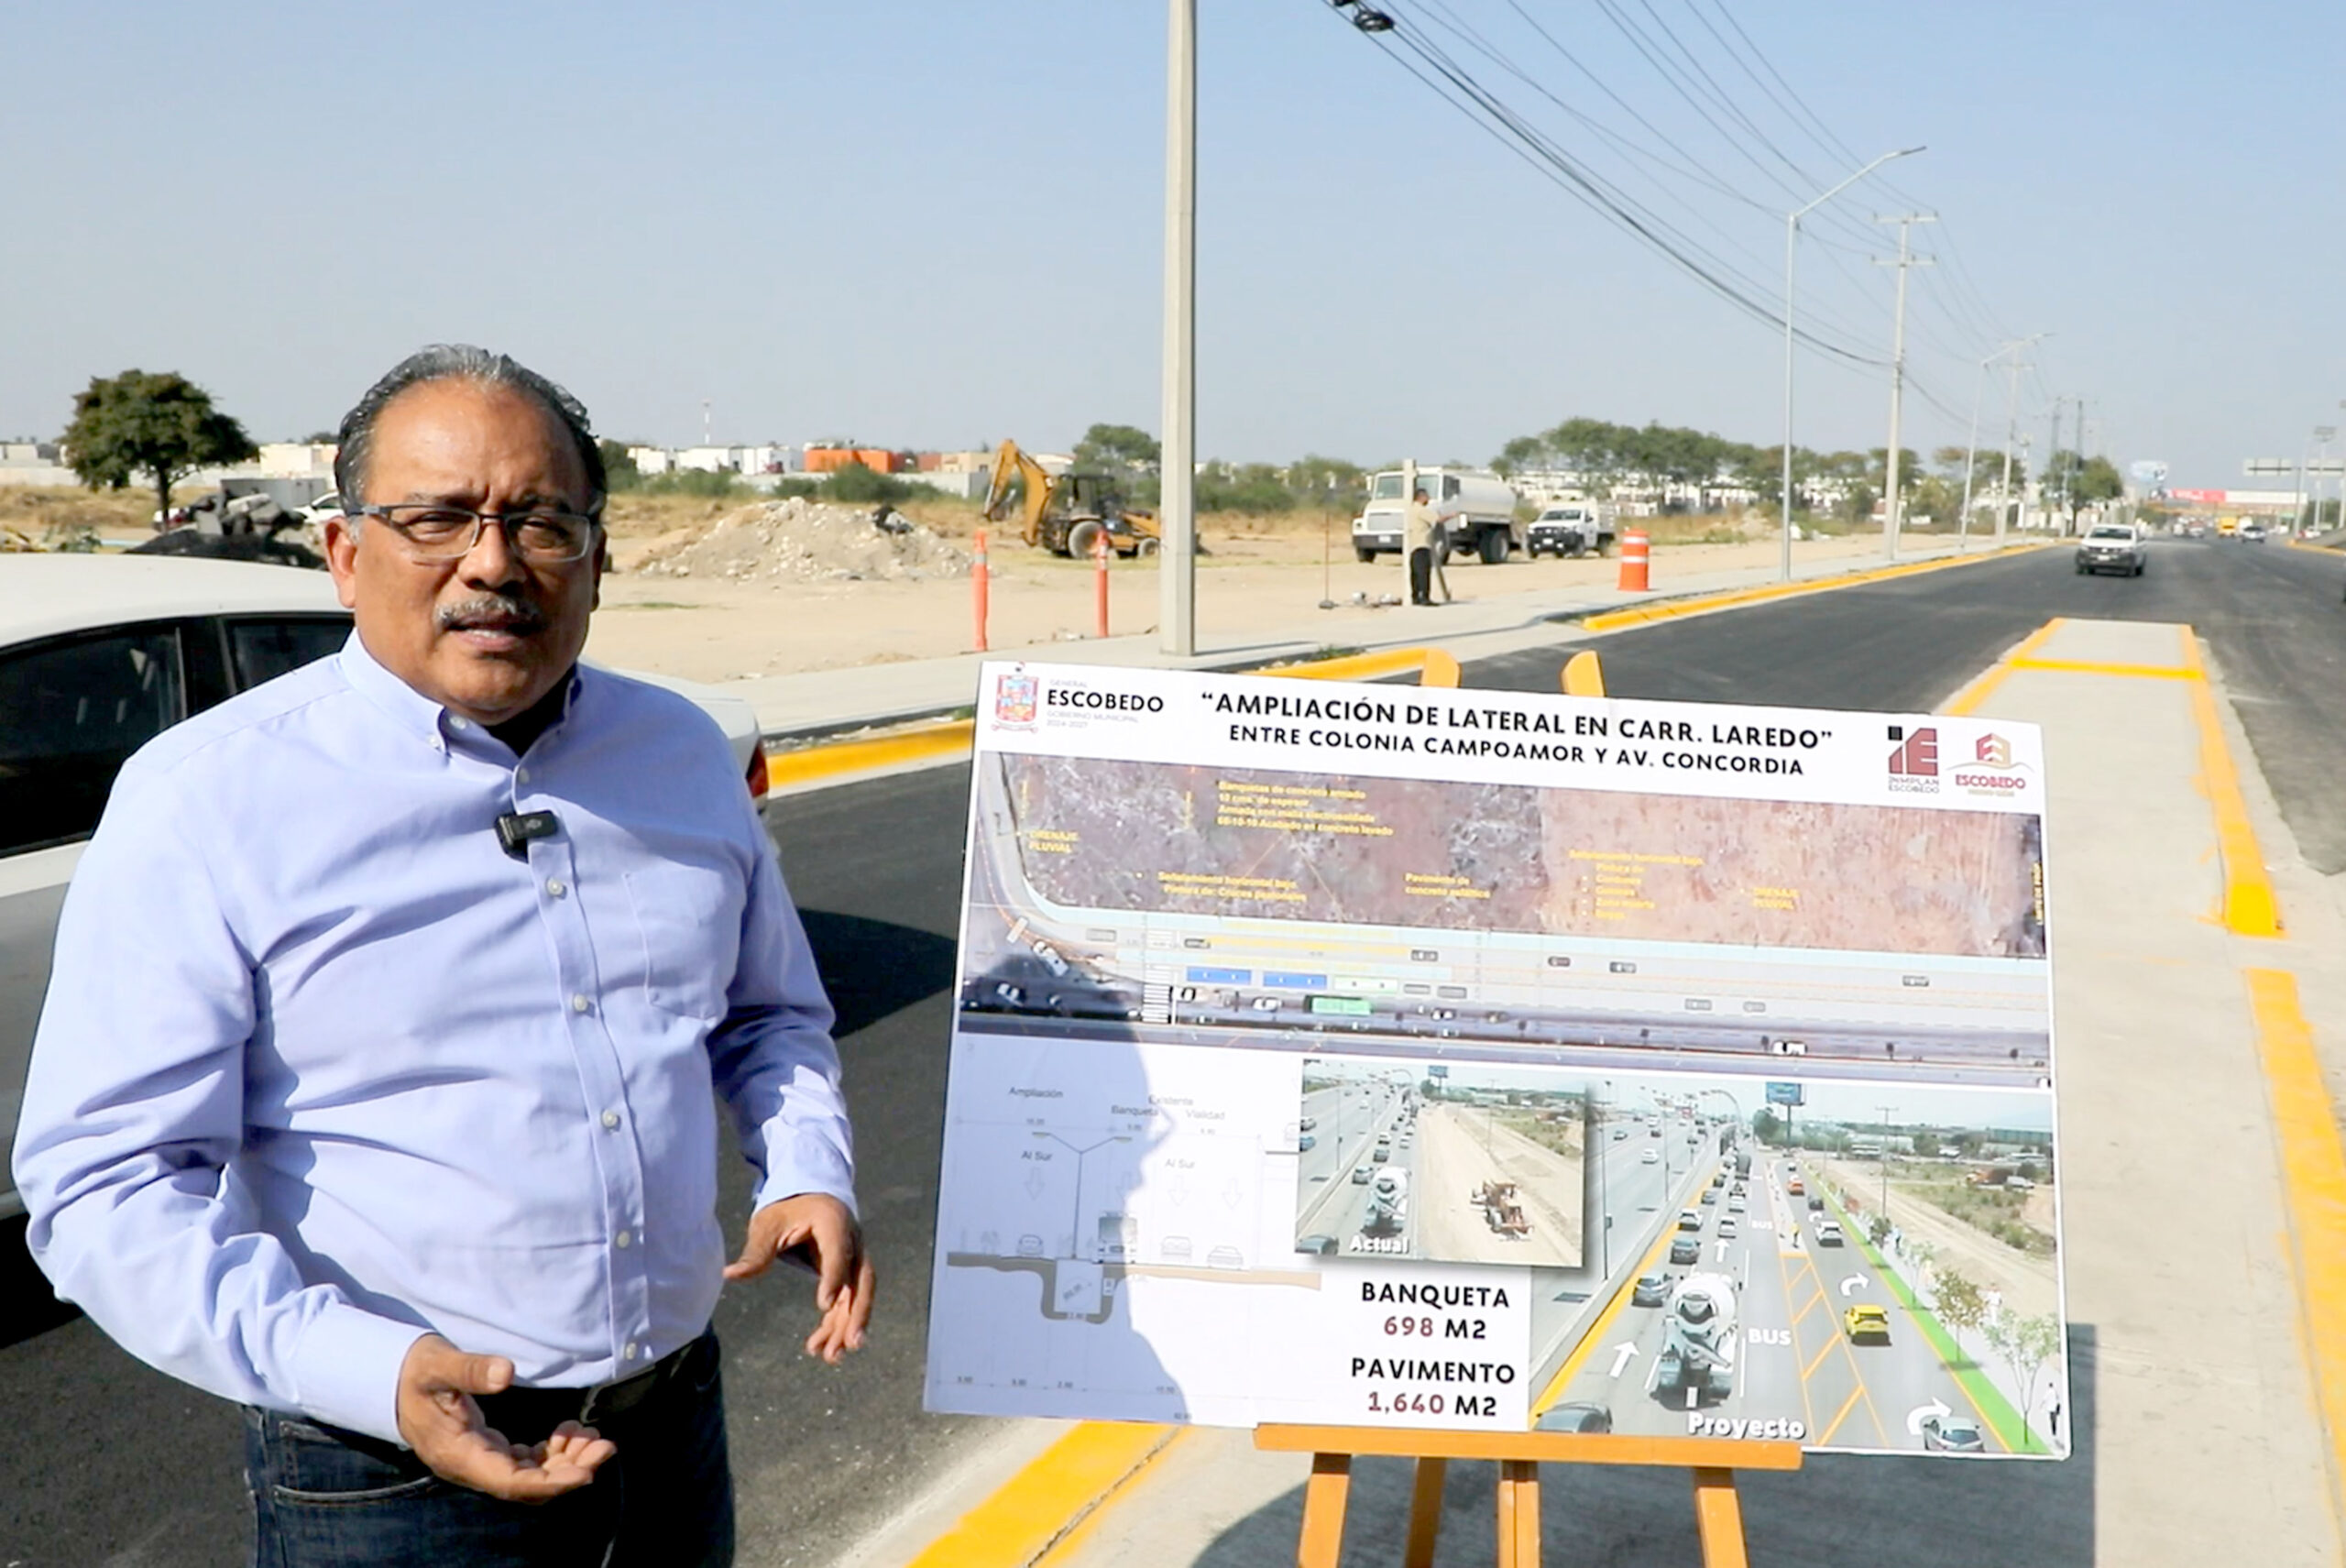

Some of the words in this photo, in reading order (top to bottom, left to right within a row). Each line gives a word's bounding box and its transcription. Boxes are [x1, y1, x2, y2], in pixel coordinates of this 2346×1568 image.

[1047, 689, 1164, 712] ESCOBEDO
[1407, 705, 1439, 726] DE
[1449, 708, 1565, 733] LATERAL
[1574, 716, 1607, 736] EN
[1619, 718, 1702, 742] CARR.
[1229, 725, 1300, 745] ENTRE
[1310, 729, 1415, 752] COLONIA
[1424, 737, 1584, 762] CAMPOAMOR
[1595, 748, 1607, 763] Y
[1617, 750, 1653, 767] AV.
[1662, 751, 1803, 775] CONCORDIA
[1888, 784, 1939, 794] ESCOBEDO
[1956, 774, 2026, 789] ESCOBEDO
[1112, 1105, 1158, 1117] Banqueta
[1186, 1109, 1225, 1120] Vialidad
[1021, 1151, 1032, 1160] Al
[1035, 1151, 1052, 1161] Sur
[1178, 1159, 1195, 1169] Sur
[1350, 1234, 1409, 1254] Actual
[1362, 1281, 1509, 1310] BANQUETA
[1384, 1316, 1433, 1337] 698
[1445, 1319, 1486, 1339] M2
[1747, 1328, 1792, 1345] BUS
[1352, 1357, 1516, 1385] PAVIMENTO
[1368, 1391, 1444, 1414] 1,640
[1454, 1395, 1496, 1417] M2
[1688, 1411, 1805, 1440] Proyecto
